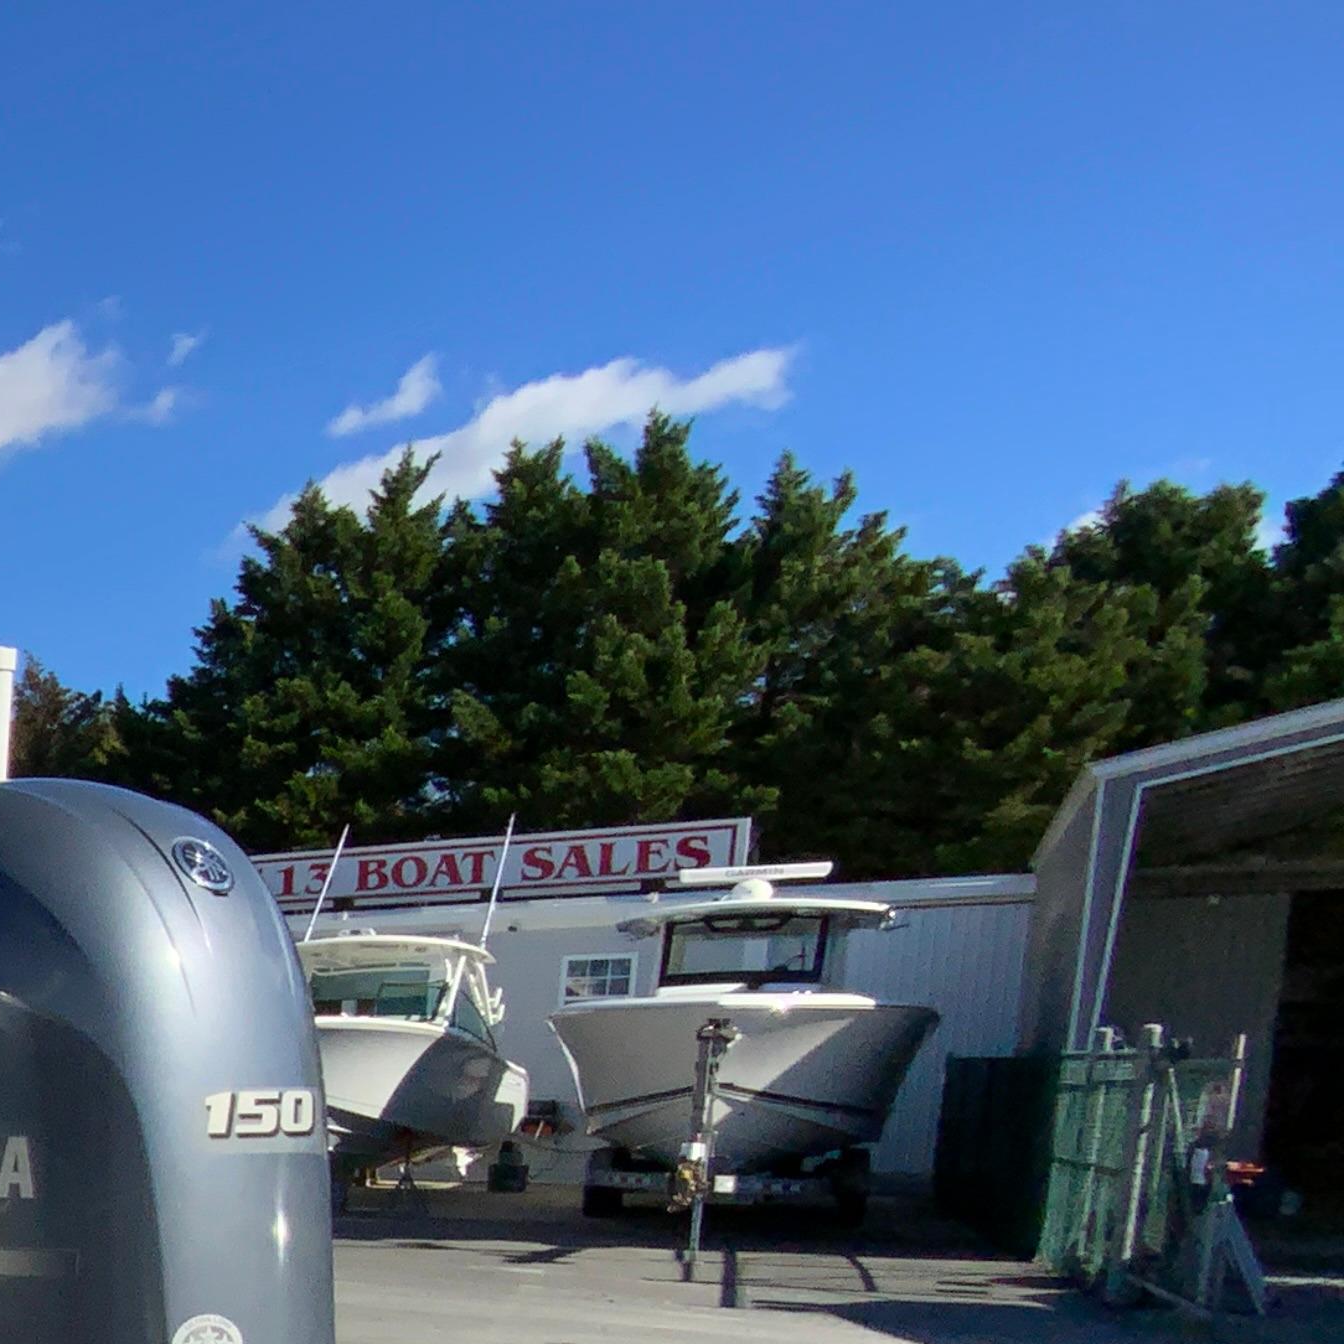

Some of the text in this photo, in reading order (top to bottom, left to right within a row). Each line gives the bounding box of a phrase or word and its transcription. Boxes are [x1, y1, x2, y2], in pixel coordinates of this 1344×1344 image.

[258, 835, 712, 897] 13 BOAT SALES
[724, 867, 785, 878] GARMIN
[204, 1090, 316, 1139] 150
